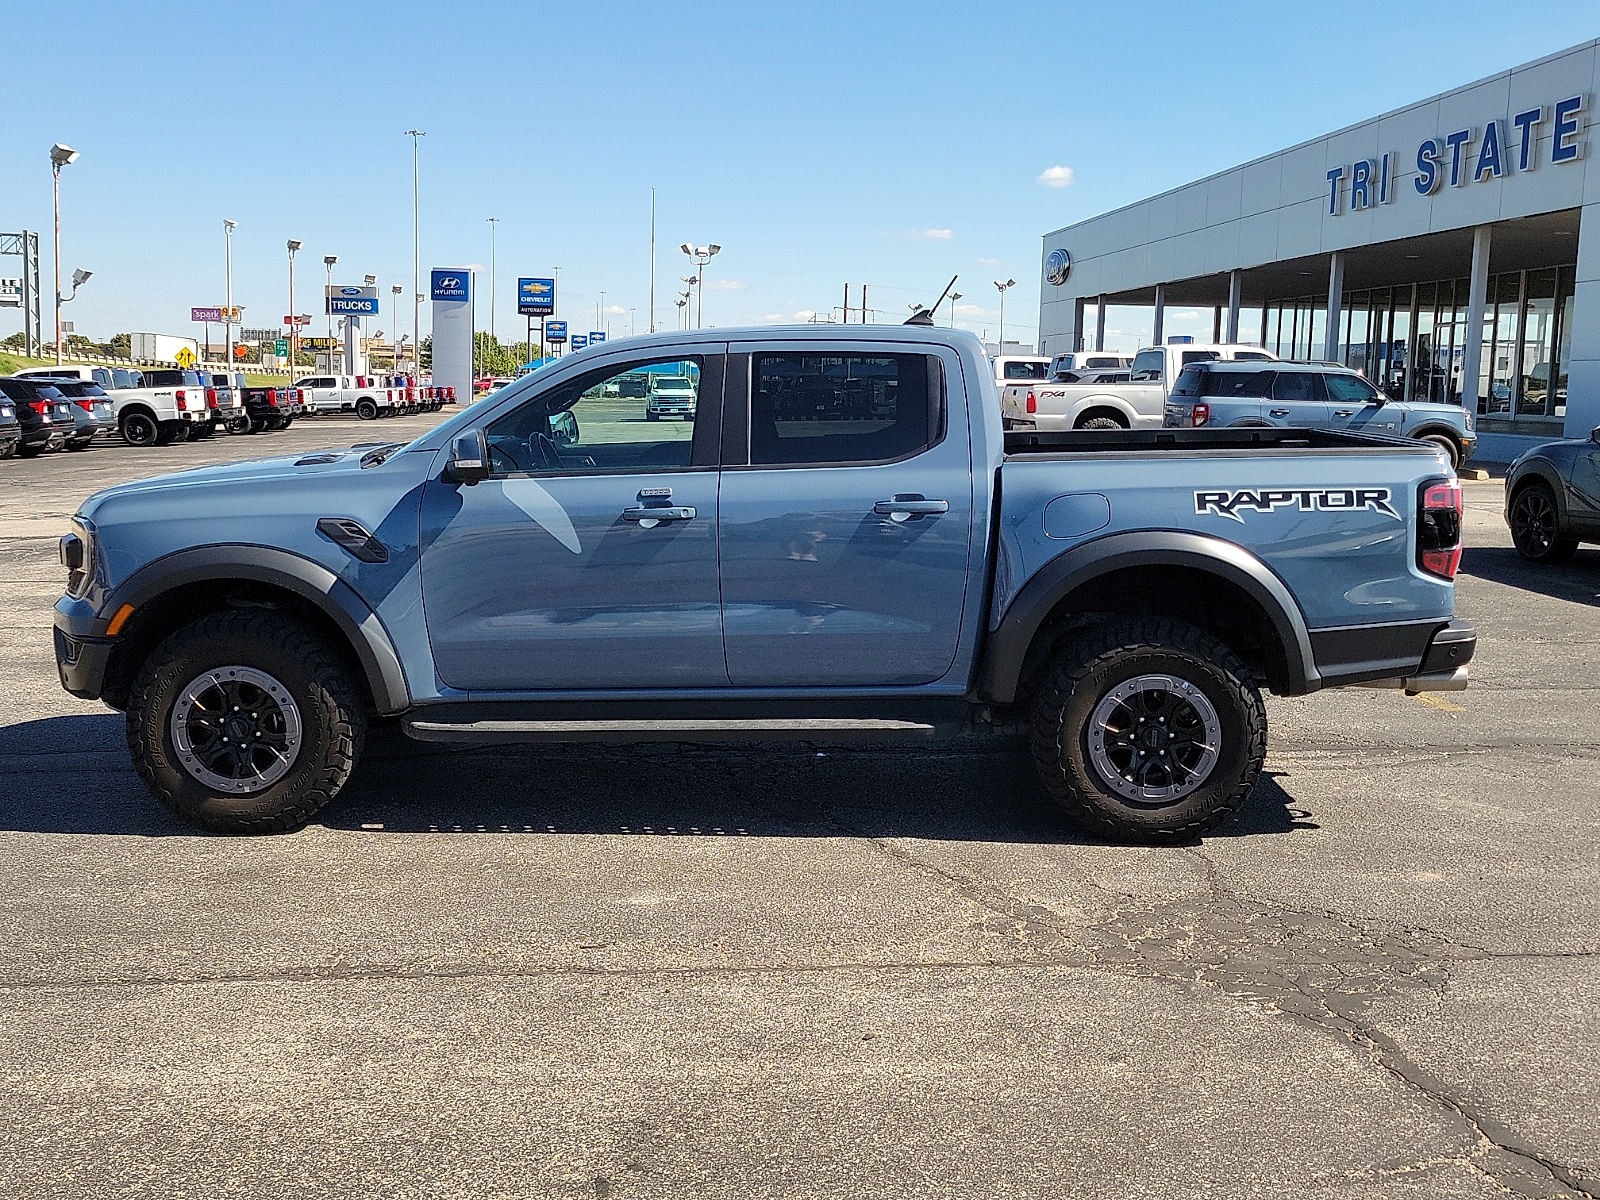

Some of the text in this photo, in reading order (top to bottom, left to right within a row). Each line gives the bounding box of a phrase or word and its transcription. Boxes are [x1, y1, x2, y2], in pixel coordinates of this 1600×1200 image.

[1326, 93, 1590, 217] TRI STATE
[194, 310, 219, 319] spark
[332, 300, 372, 311] TRUCKS
[1194, 488, 1403, 525] RAPTOR
